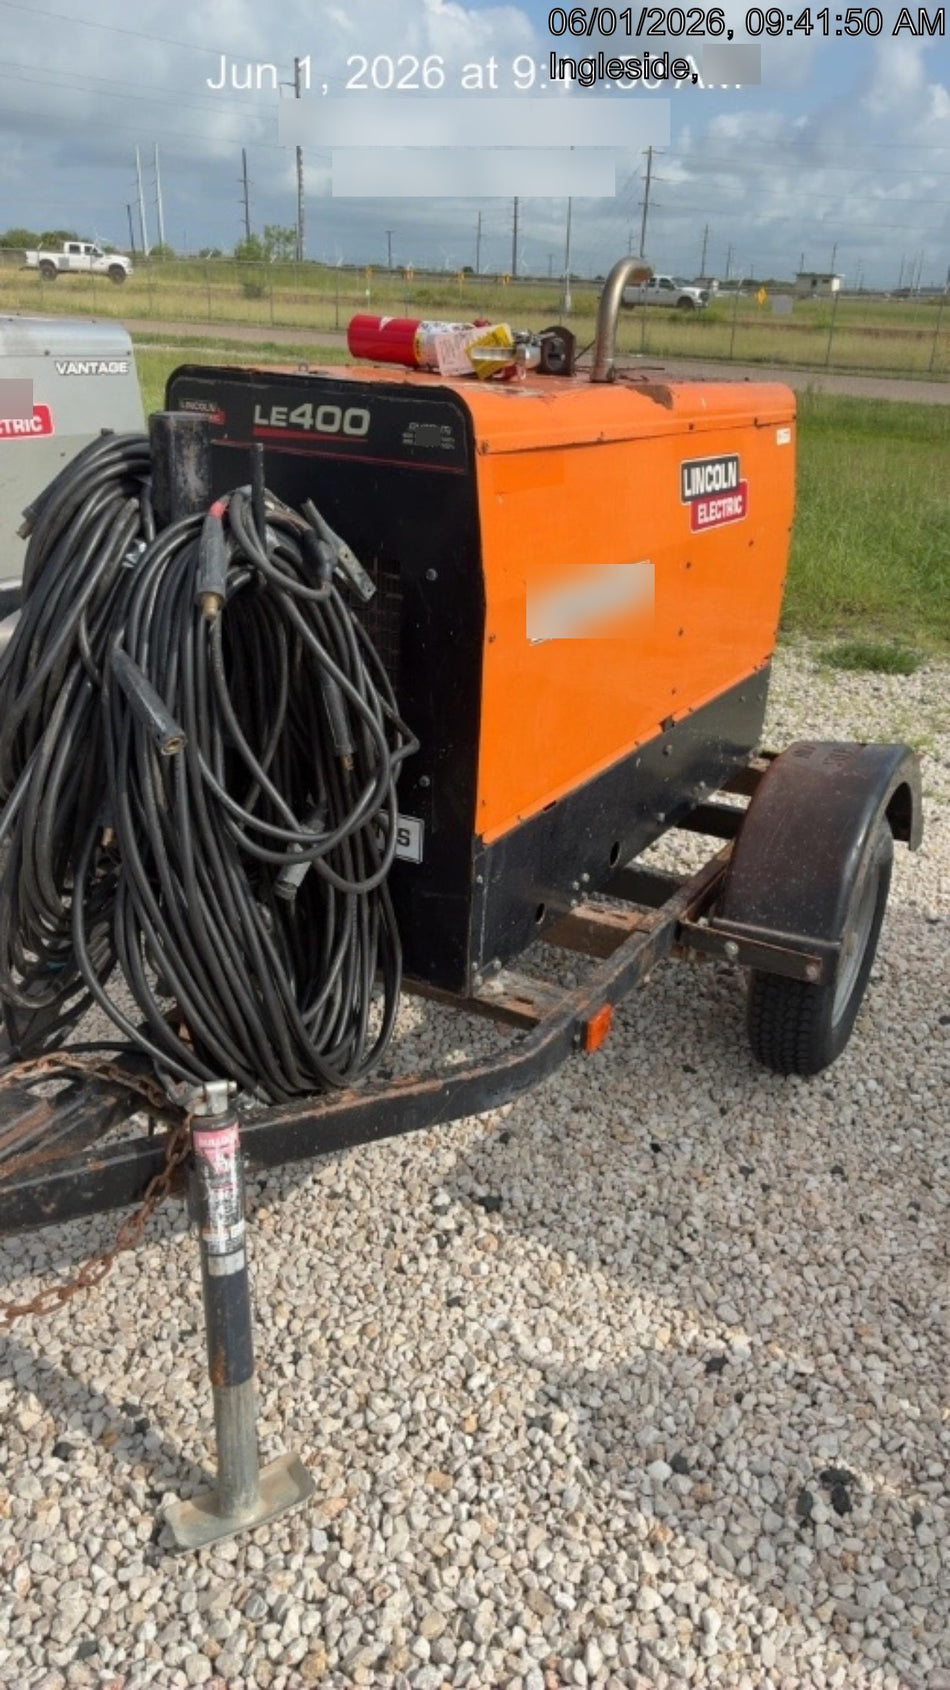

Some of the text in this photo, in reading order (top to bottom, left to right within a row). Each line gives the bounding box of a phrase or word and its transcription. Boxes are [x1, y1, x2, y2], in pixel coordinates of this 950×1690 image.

[55, 360, 129, 376] VANTAGE
[0, 416, 43, 434] TRIC
[253, 402, 371, 436] LE400
[683, 460, 738, 498] LINCOLN
[697, 494, 743, 525] ELECTRIC
